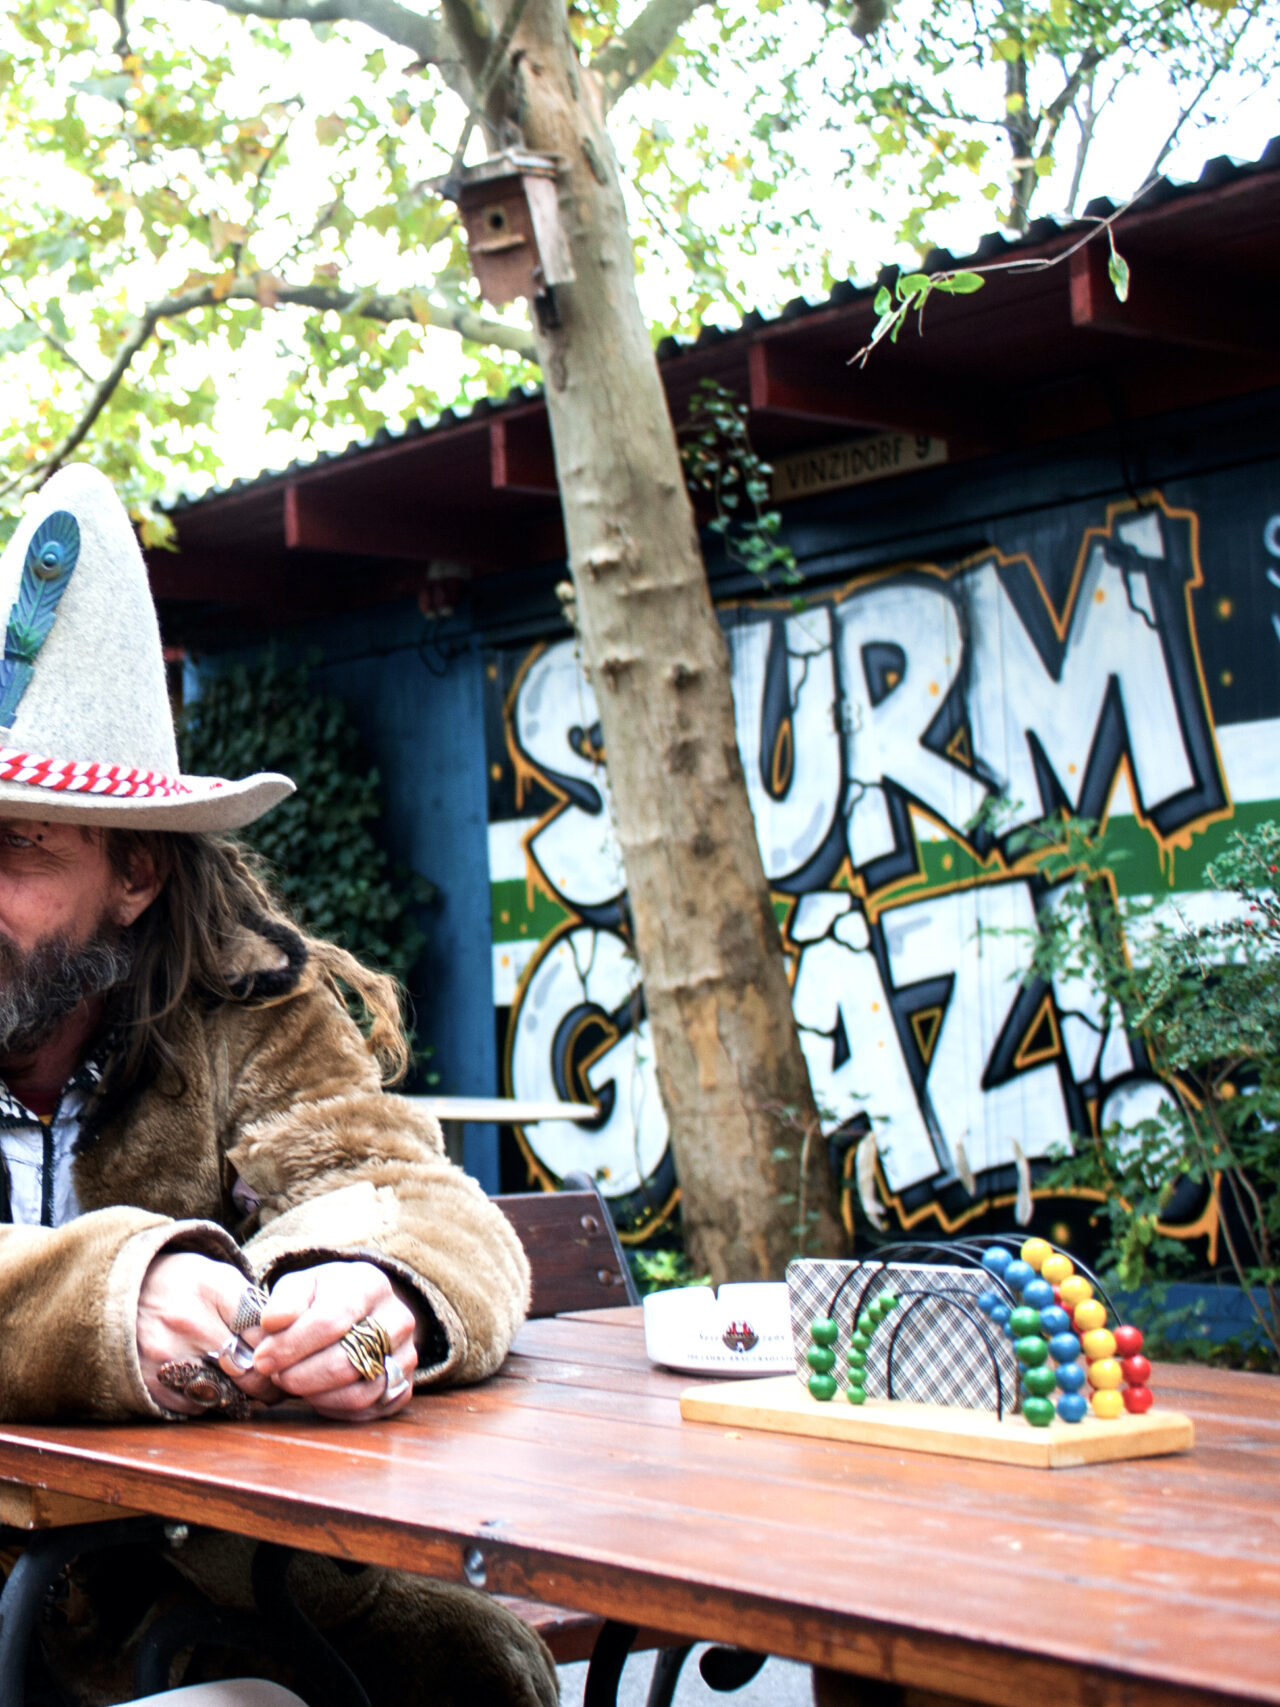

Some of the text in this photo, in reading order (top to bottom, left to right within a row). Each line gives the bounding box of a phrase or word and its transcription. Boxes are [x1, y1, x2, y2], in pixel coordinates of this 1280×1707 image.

[786, 436, 903, 490] VINZIDORF
[512, 510, 1202, 910] SURM
[508, 878, 1190, 1202] GAZ!
